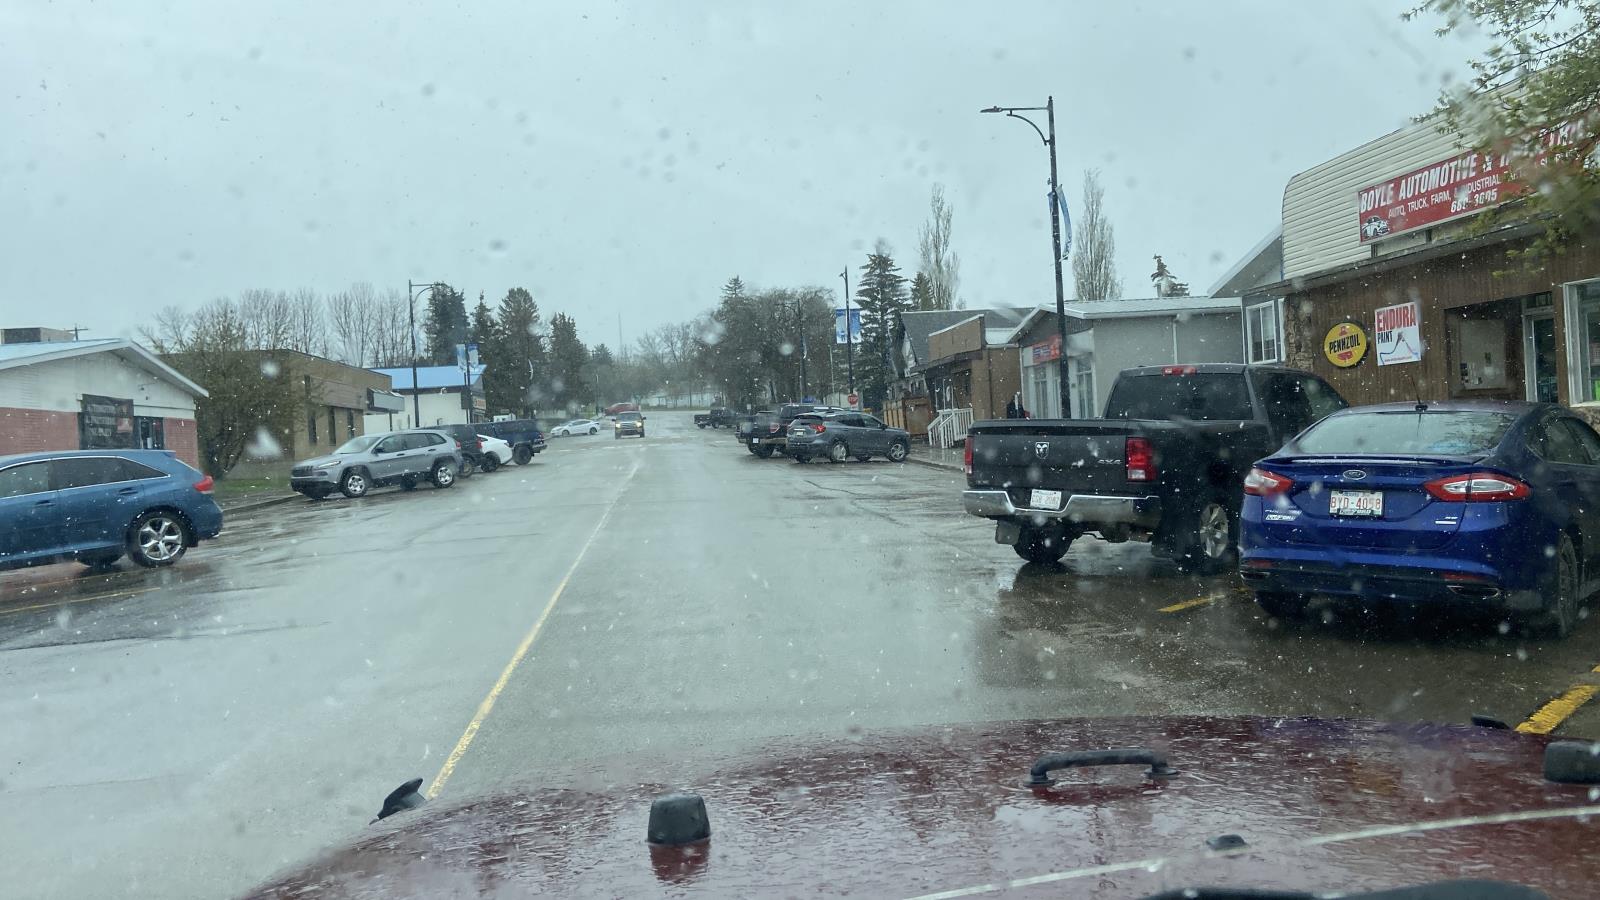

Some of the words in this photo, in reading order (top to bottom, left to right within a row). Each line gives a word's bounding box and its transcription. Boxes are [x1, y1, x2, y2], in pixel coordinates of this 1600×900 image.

[1360, 183, 1394, 213] BOYLE
[1399, 153, 1478, 201] AUTOMOTIVE
[1388, 204, 1407, 219] AUTO,
[1407, 196, 1430, 213] TRUCK,
[1430, 189, 1452, 205] FARM,
[1461, 173, 1501, 194] DUSTRIAL
[1376, 304, 1417, 333] ENDURA
[1328, 333, 1361, 354] PENNZOIL
[1377, 331, 1393, 344] PAINT
